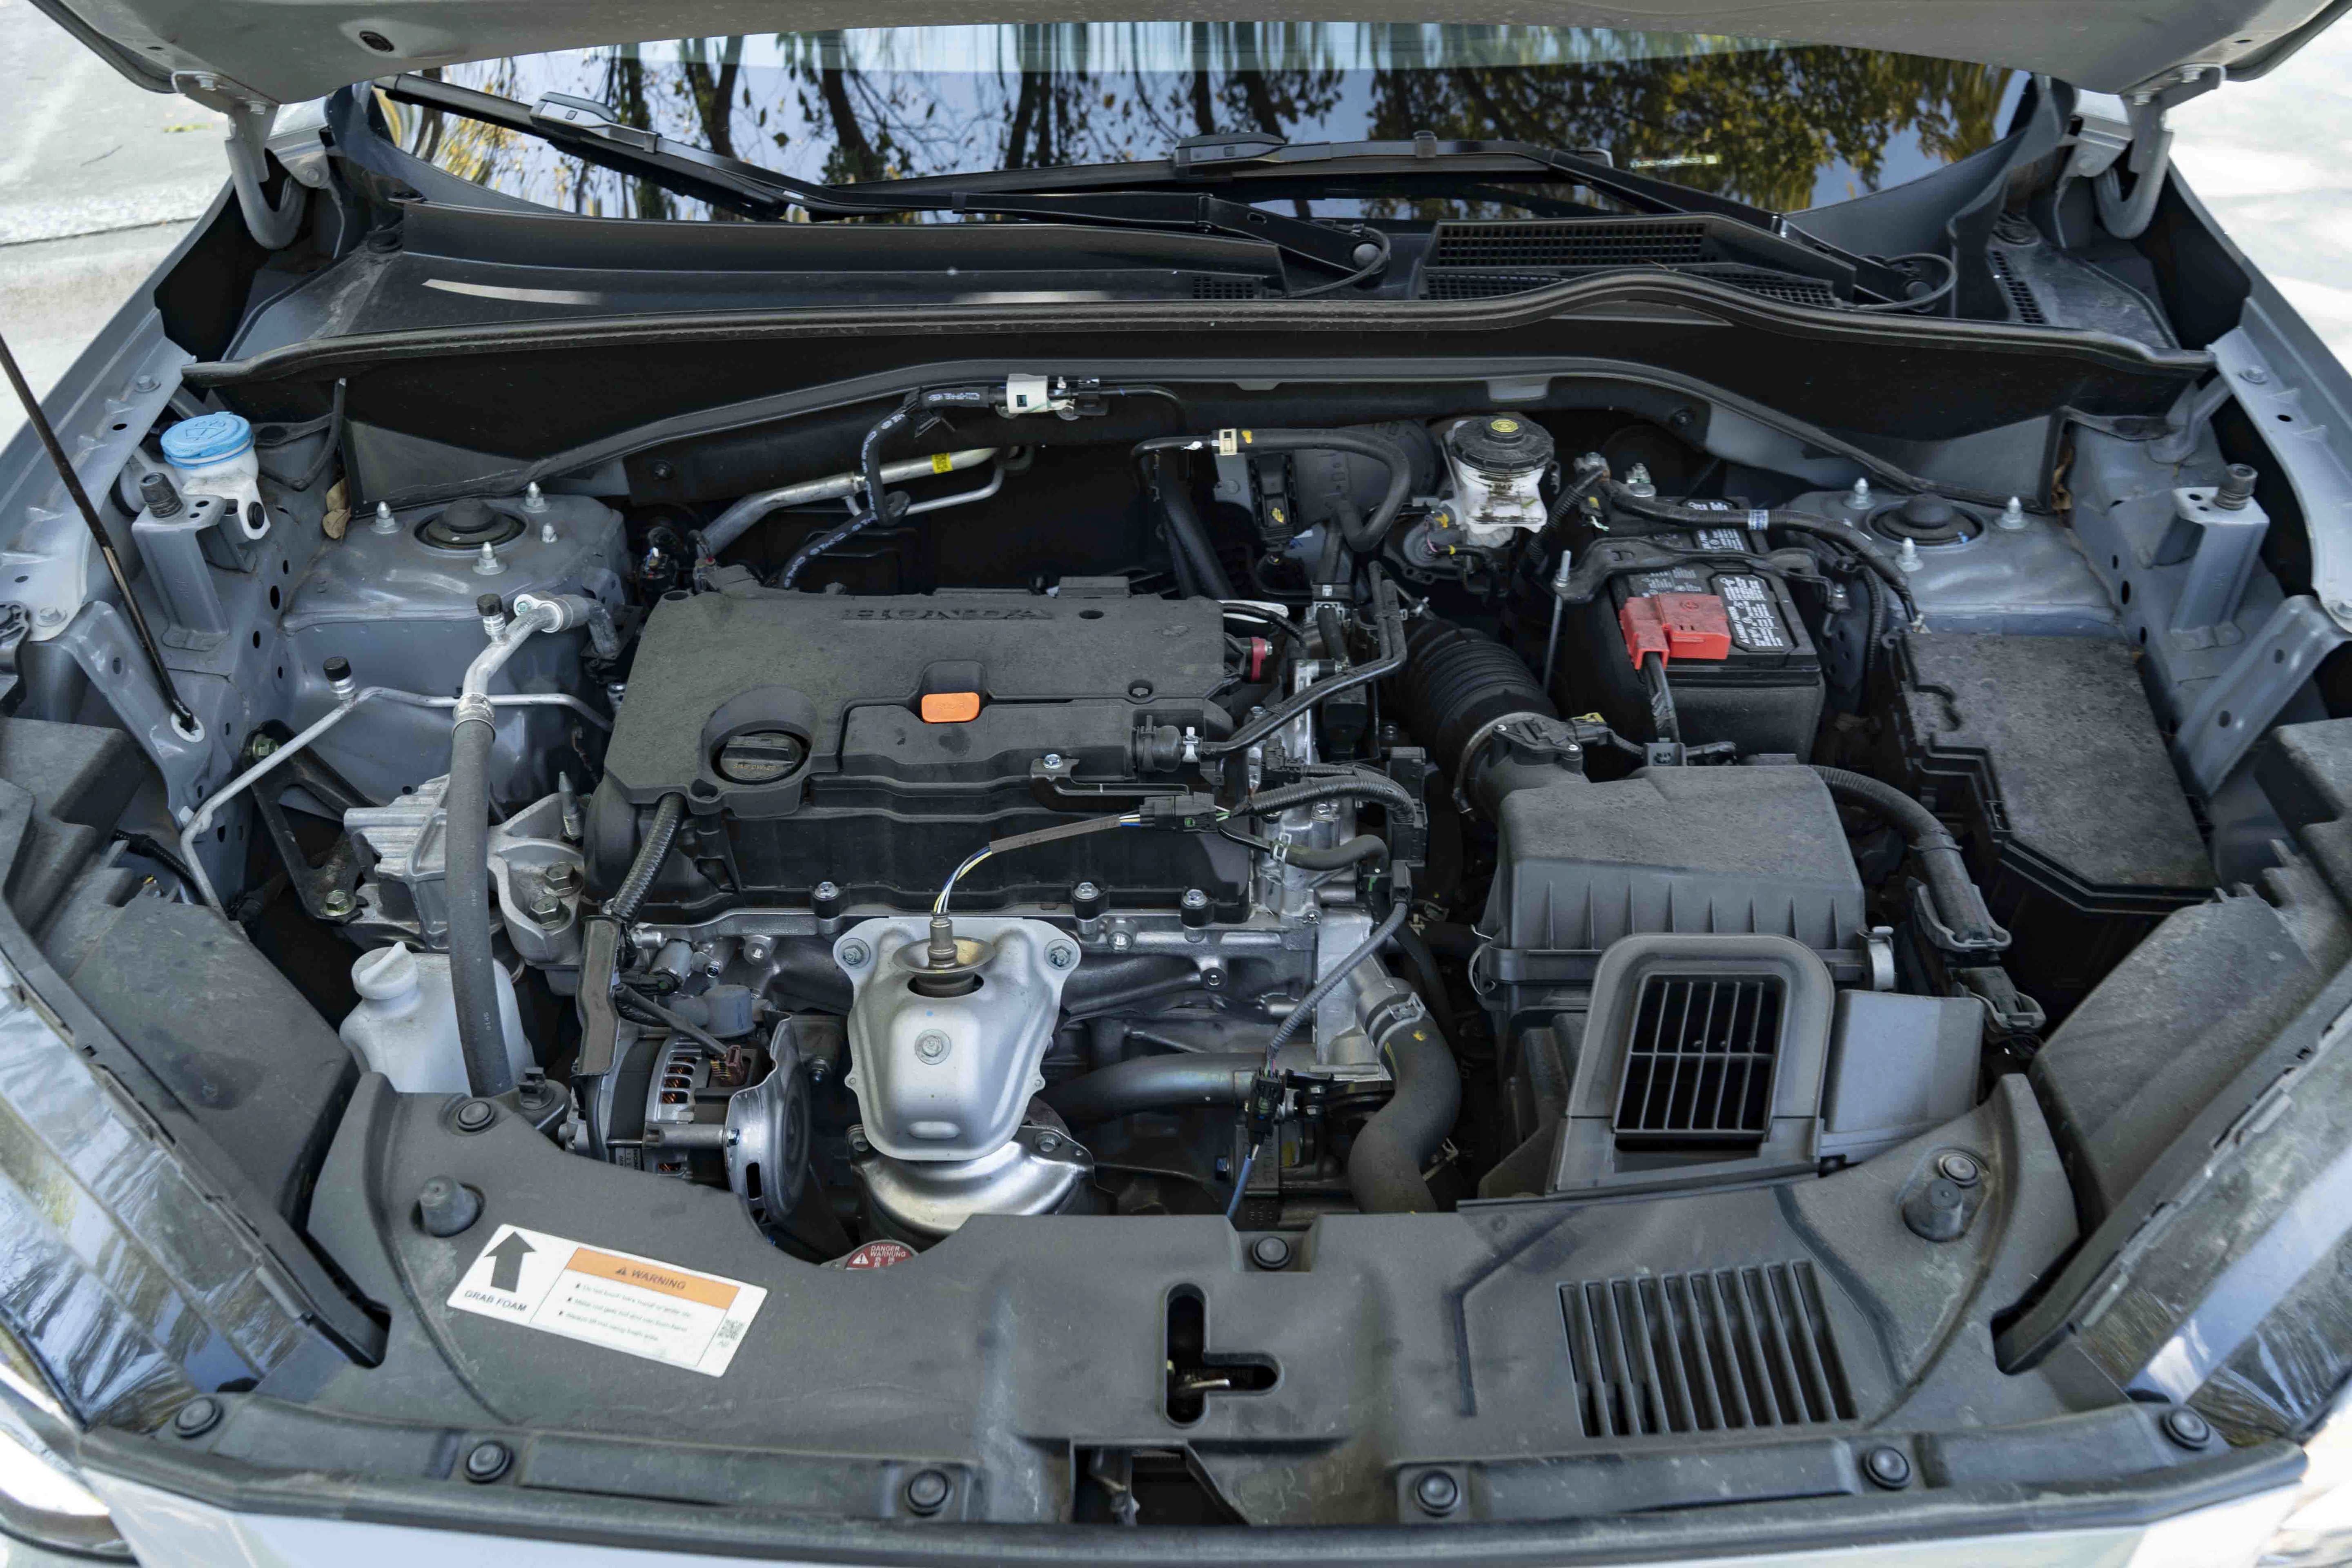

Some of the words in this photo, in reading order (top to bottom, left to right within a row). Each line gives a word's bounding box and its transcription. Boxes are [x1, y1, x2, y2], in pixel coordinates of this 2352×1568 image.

[842, 608, 1053, 621] HONDA
[631, 1270, 686, 1290] WARNING
[464, 1290, 494, 1303] GRAB
[496, 1298, 527, 1311] FOAM
